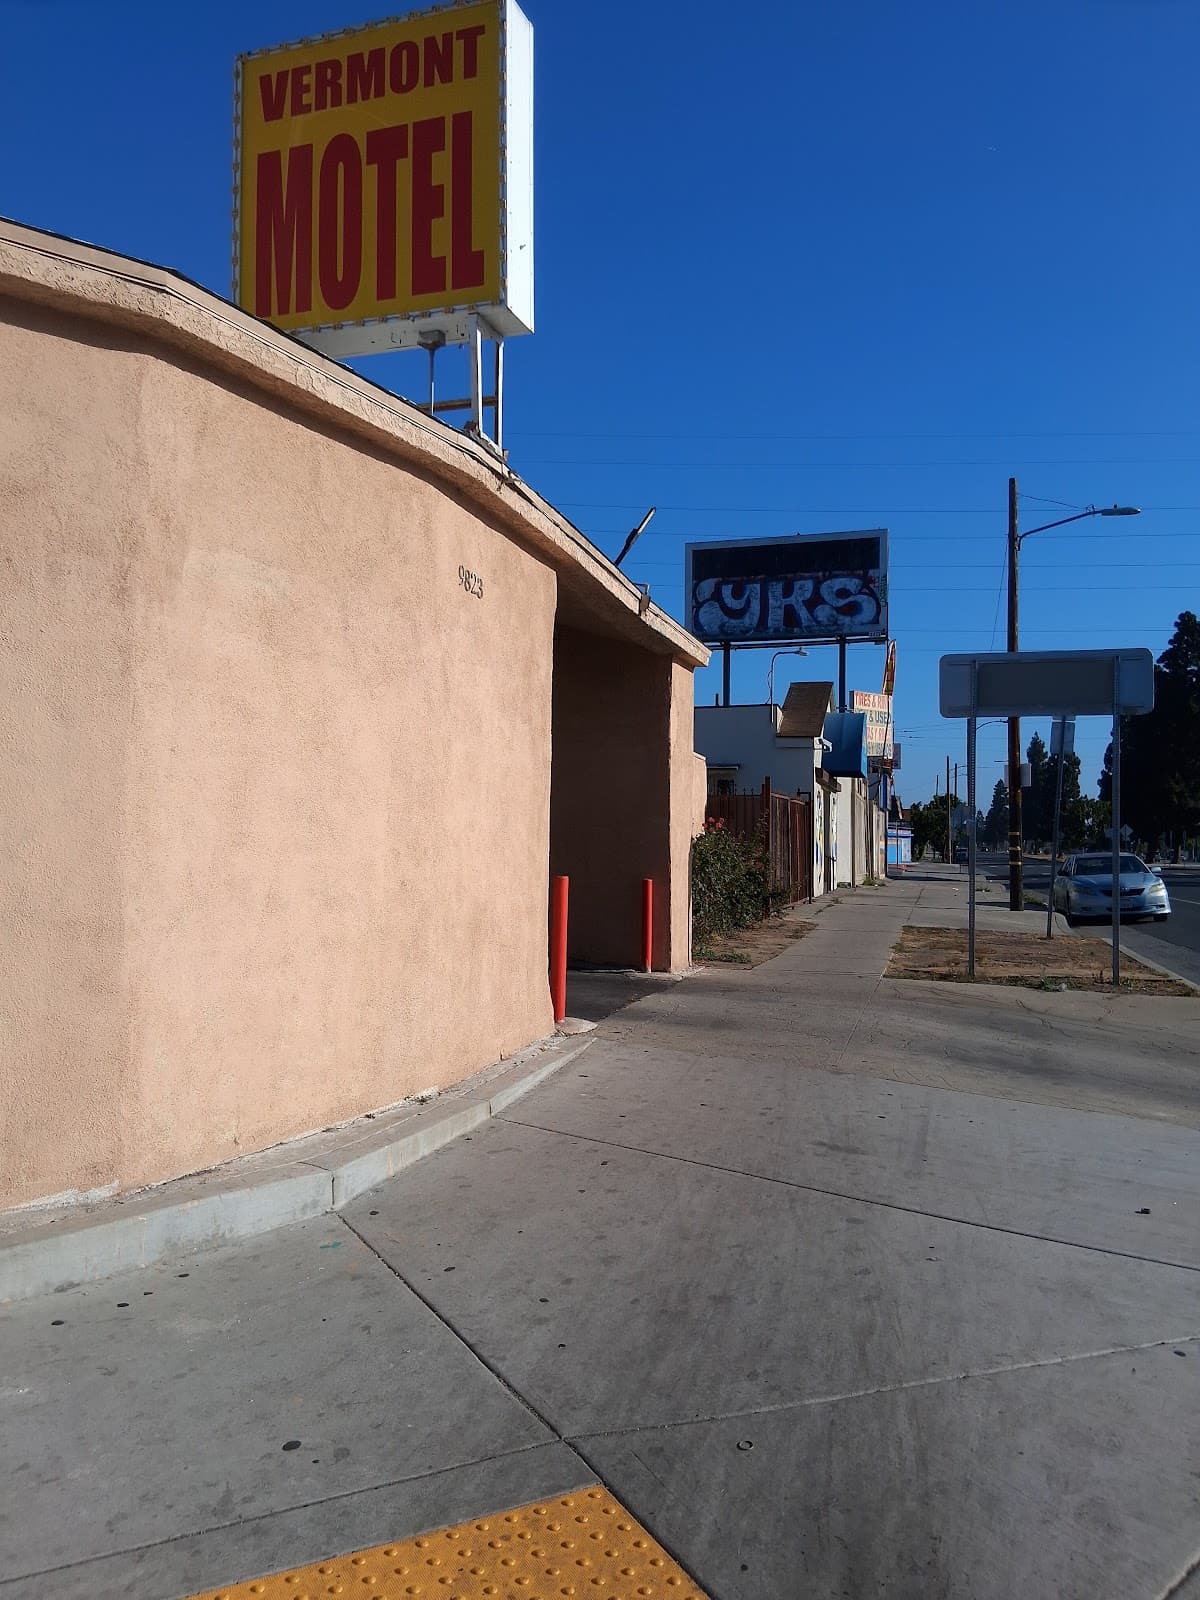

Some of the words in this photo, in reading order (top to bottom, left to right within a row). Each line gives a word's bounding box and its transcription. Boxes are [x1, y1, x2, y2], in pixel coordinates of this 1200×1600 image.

[259, 24, 486, 123] VERMONT
[254, 110, 485, 319] MOTEL
[458, 565, 484, 600] 9823
[855, 692, 871, 707] TIRES
[868, 711, 874, 722] &
[875, 711, 892, 725] USED
